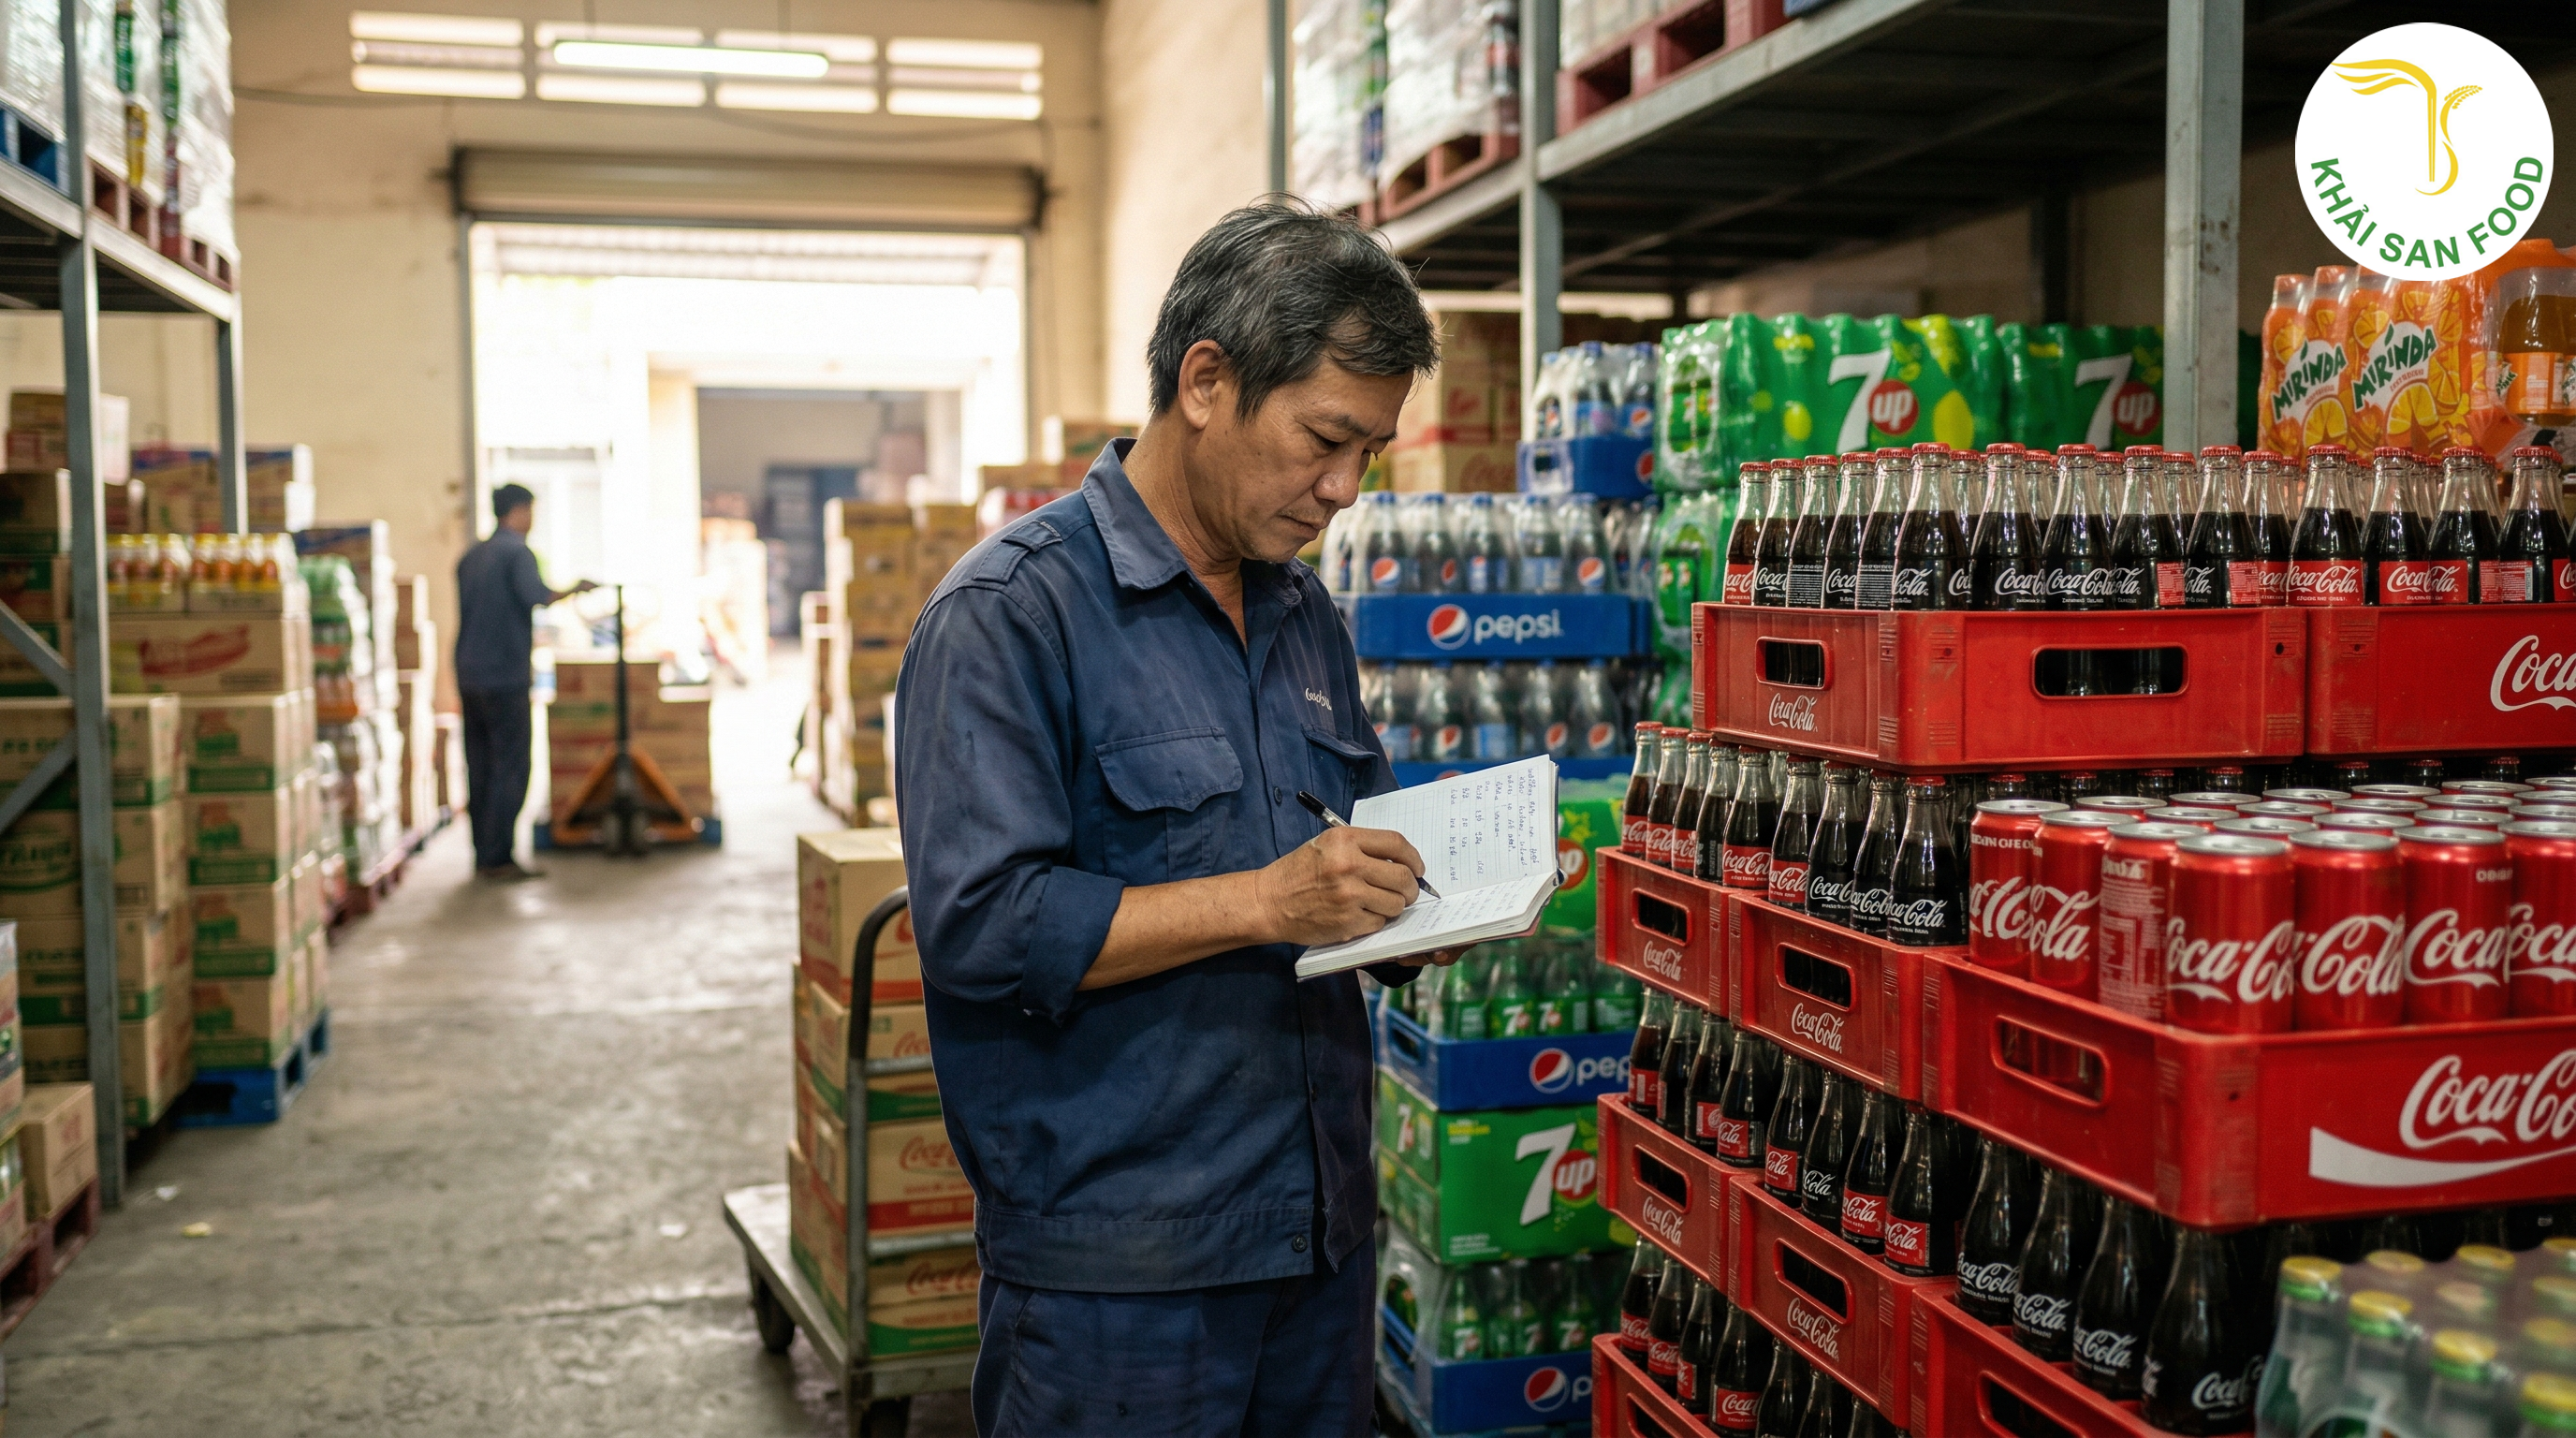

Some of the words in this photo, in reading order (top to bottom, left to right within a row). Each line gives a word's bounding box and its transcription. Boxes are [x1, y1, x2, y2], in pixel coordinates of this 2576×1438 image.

[2273, 341, 2348, 420] MIRINDA
[2352, 323, 2437, 410] MIRINDA
[1474, 609, 1561, 644] pepsi
[1768, 692, 1819, 733] Coca-Cola
[1792, 1003, 1845, 1054] Coca-Cola
[1576, 1055, 1631, 1087] pep
